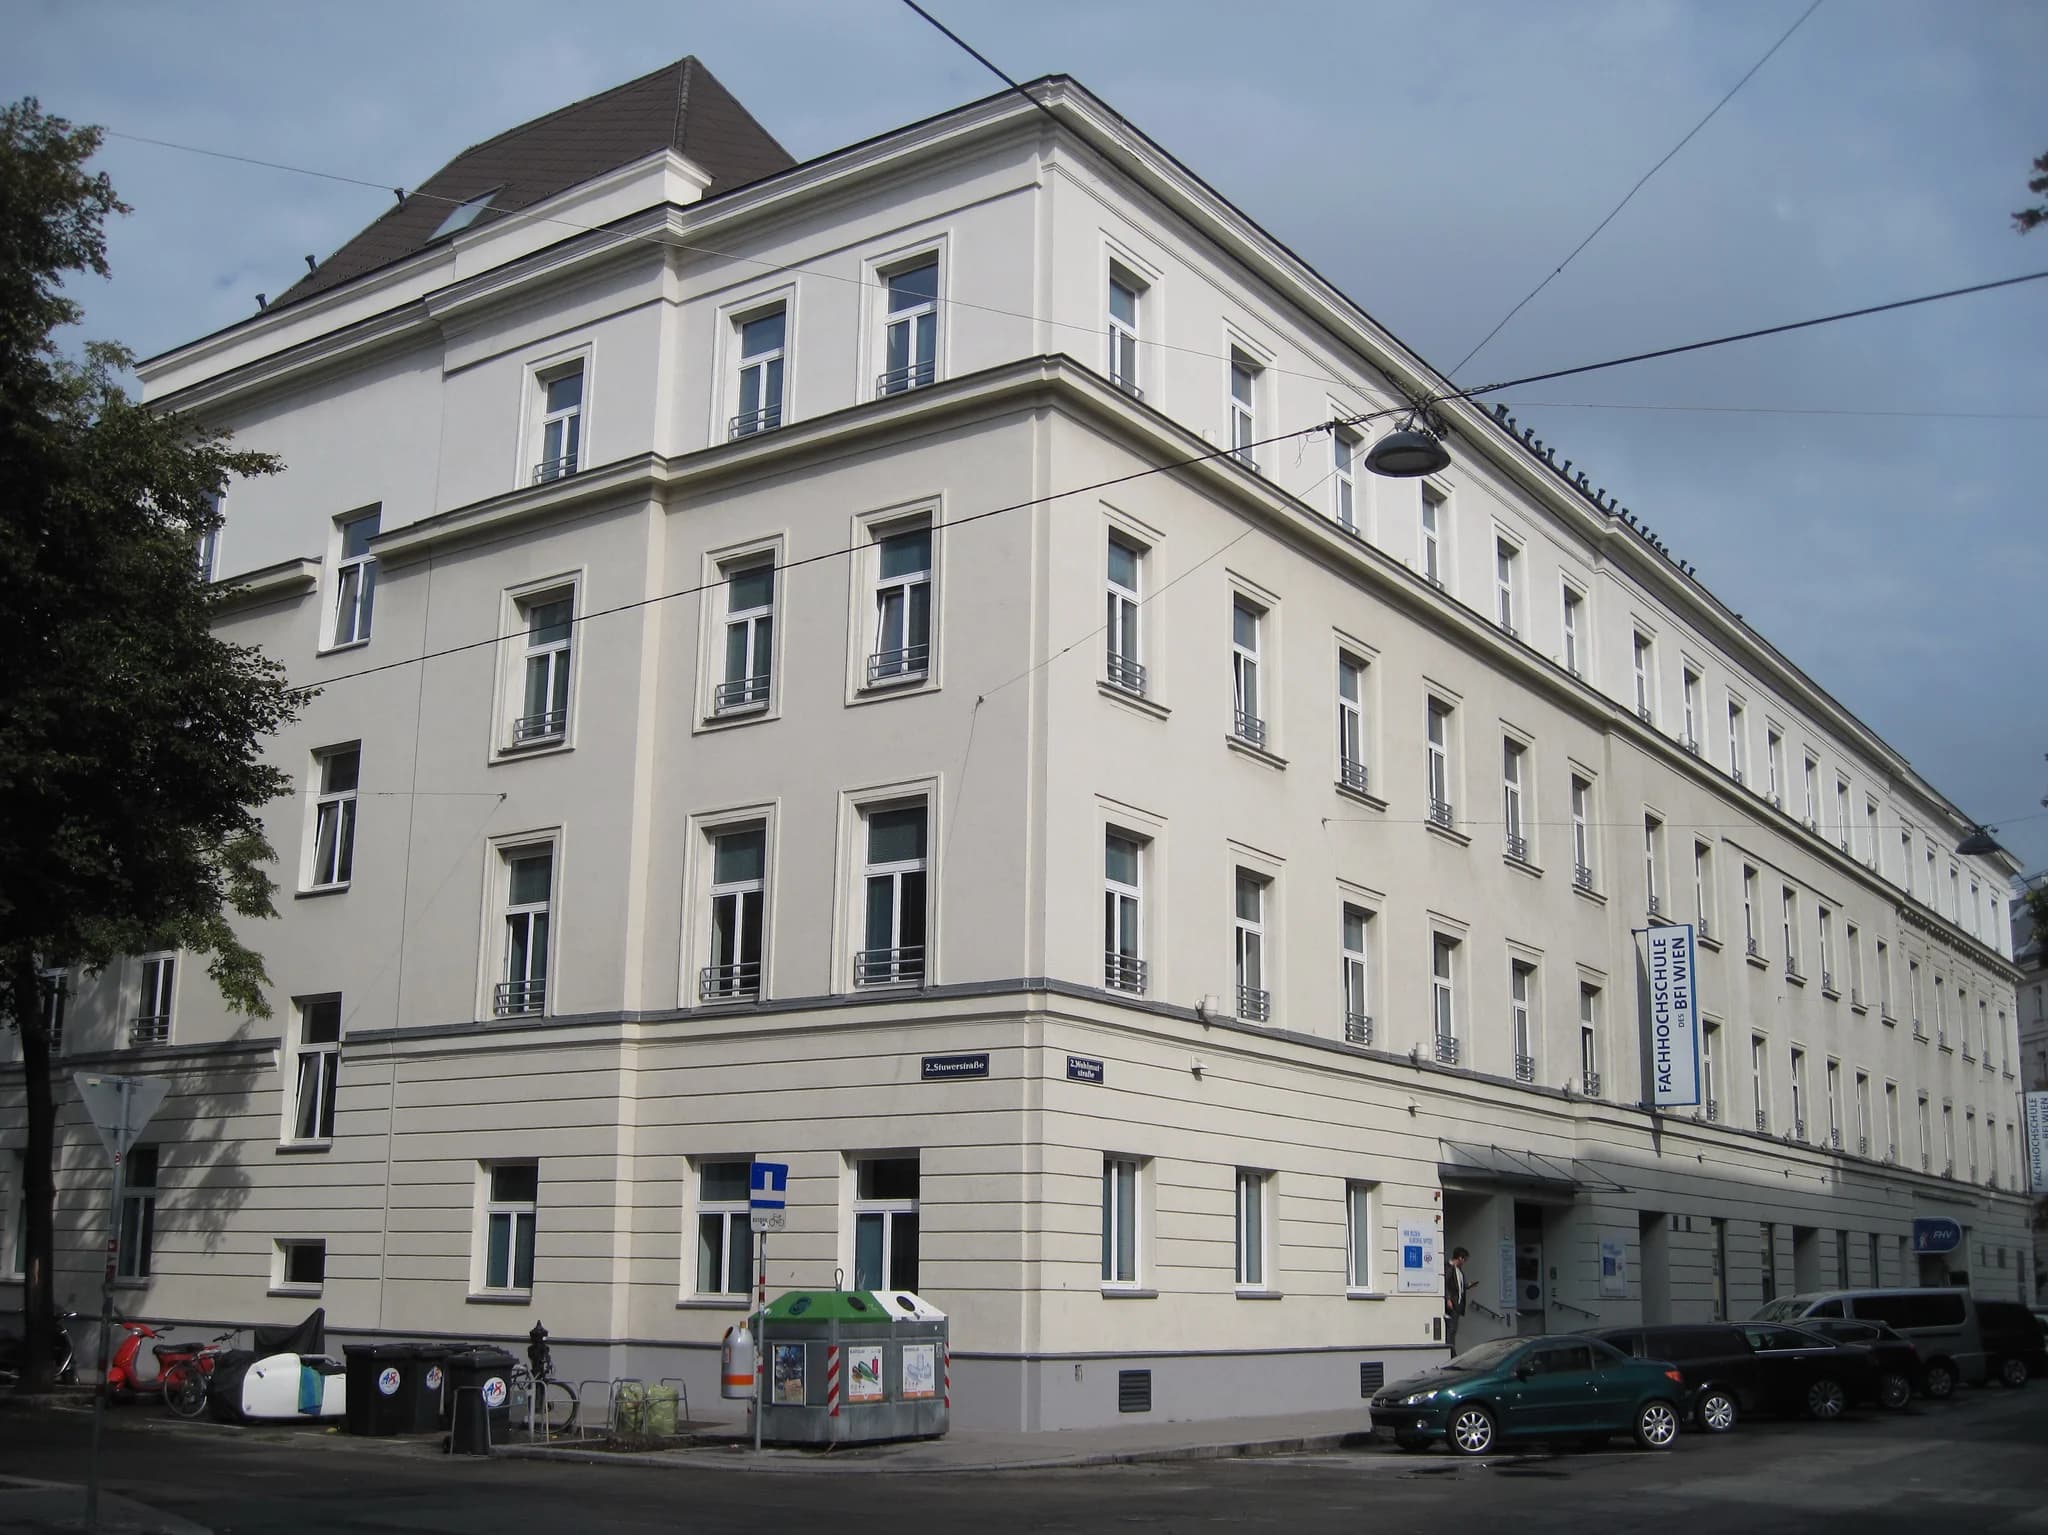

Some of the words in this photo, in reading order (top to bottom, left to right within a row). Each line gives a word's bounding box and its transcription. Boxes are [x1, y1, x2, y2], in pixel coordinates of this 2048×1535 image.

[1671, 936, 1687, 984] WIEN
[1652, 938, 1672, 1093] FACHHOCHSCHULE
[1674, 986, 1688, 1010] BFI
[2028, 1097, 2042, 1186] FACHHOCHSCHULE
